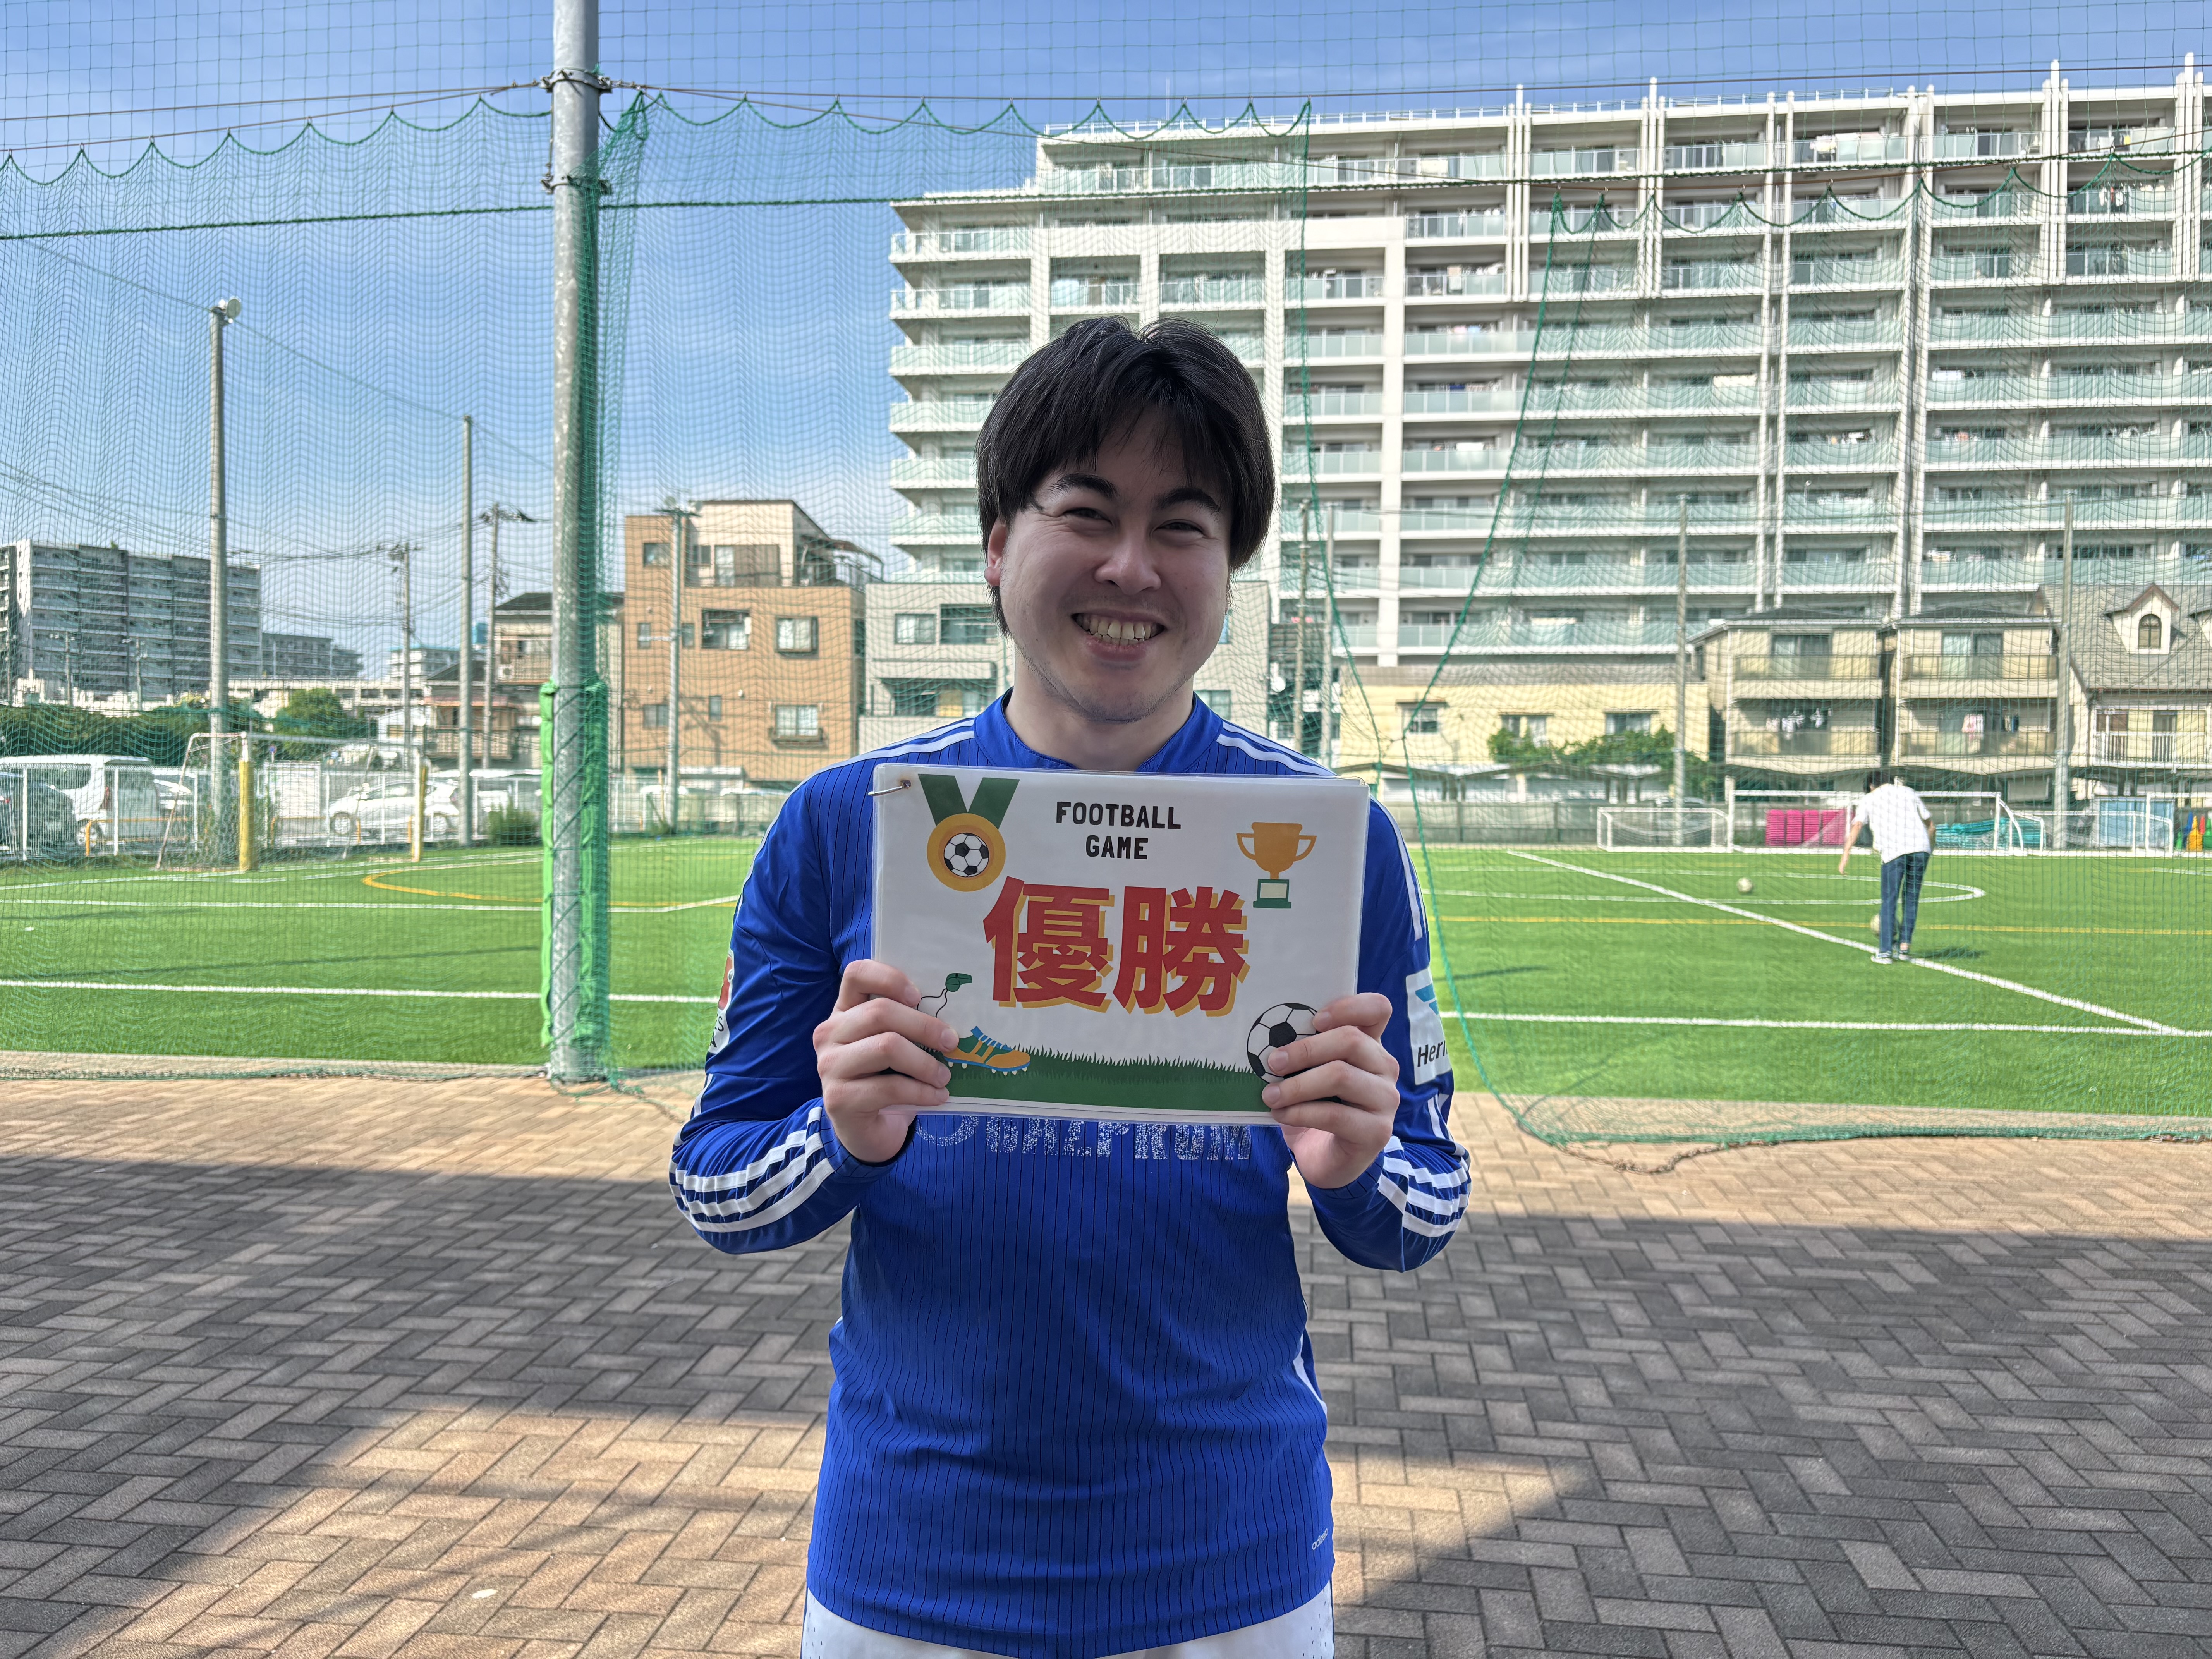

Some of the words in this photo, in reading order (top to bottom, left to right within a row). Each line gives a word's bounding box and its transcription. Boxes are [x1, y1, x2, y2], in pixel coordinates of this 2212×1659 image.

[1056, 801, 1181, 830] FOOTBALL
[1085, 835, 1149, 860] GAME
[983, 876, 1250, 1017] 優勝
